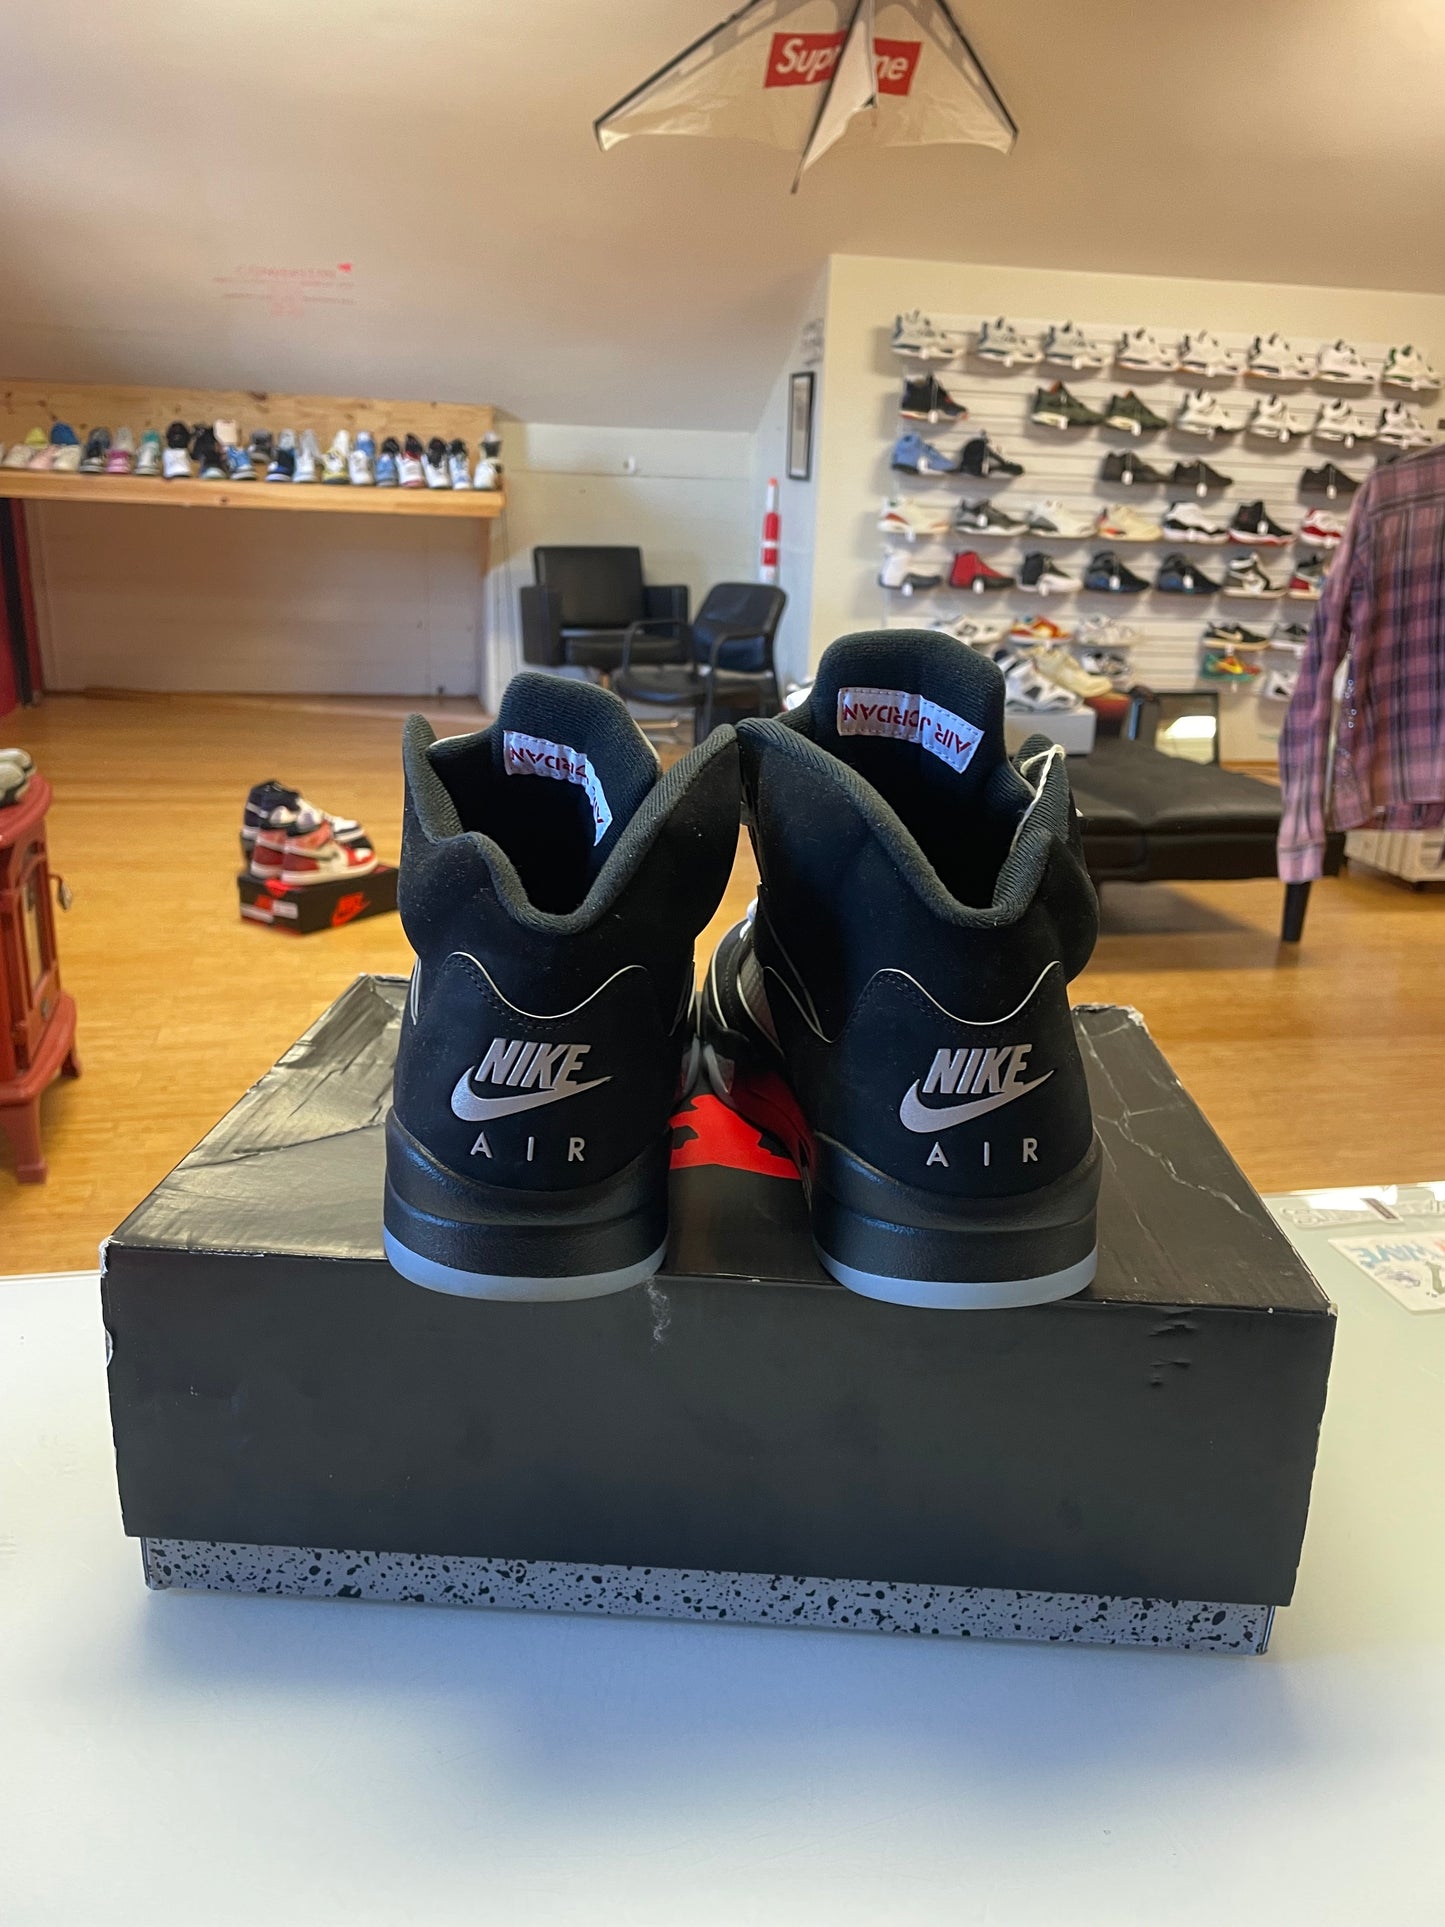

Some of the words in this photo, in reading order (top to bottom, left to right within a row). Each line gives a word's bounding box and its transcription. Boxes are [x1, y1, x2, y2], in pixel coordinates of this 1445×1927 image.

[776, 38, 909, 82] Supe
[842, 703, 932, 732] JORDAN
[934, 722, 972, 754] AIR
[474, 1037, 592, 1089] NIKE
[922, 1043, 1033, 1094] NIKE
[470, 1131, 586, 1162] AIR
[926, 1137, 1039, 1168] AIR
